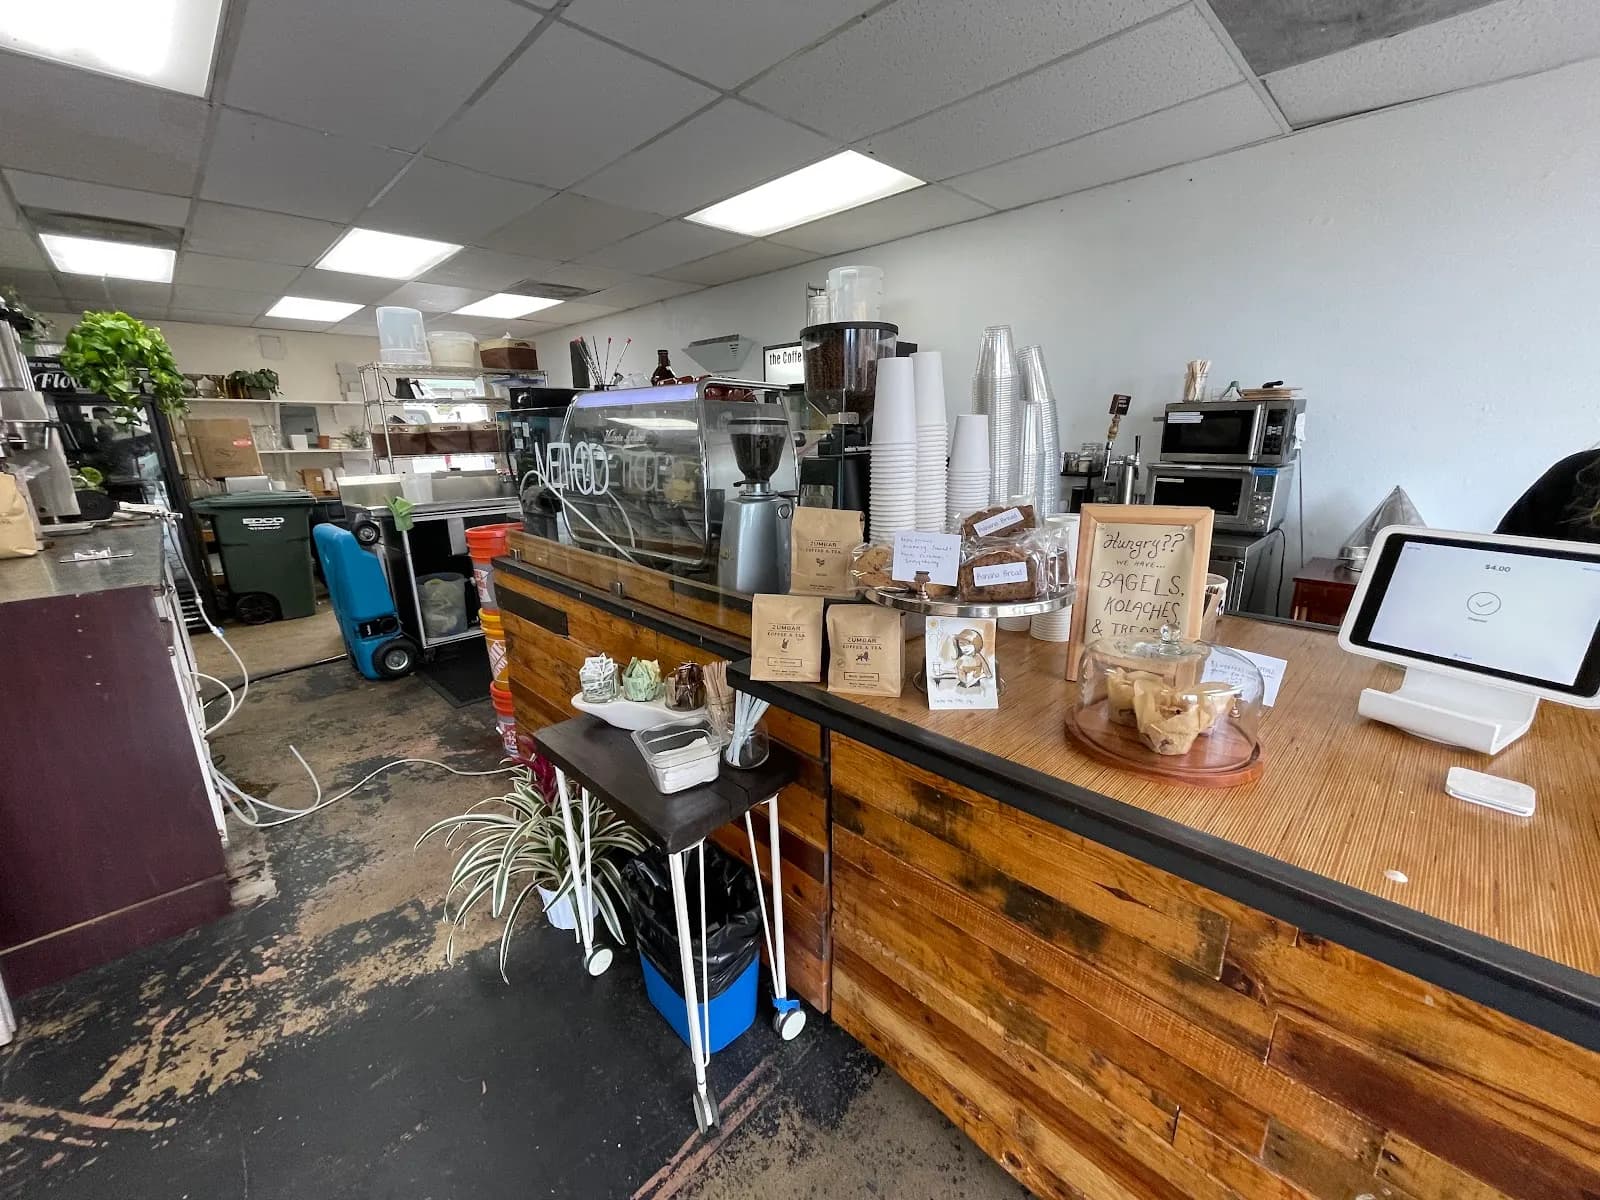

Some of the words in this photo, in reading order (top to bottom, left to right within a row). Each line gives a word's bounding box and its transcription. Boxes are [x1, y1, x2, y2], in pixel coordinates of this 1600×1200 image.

[769, 353, 781, 366] the
[782, 350, 802, 365] Coffe
[1103, 531, 1185, 560] Hungry??
[1116, 559, 1130, 567] WE
[1485, 564, 1512, 573] $4.00
[1091, 618, 1103, 637] &
